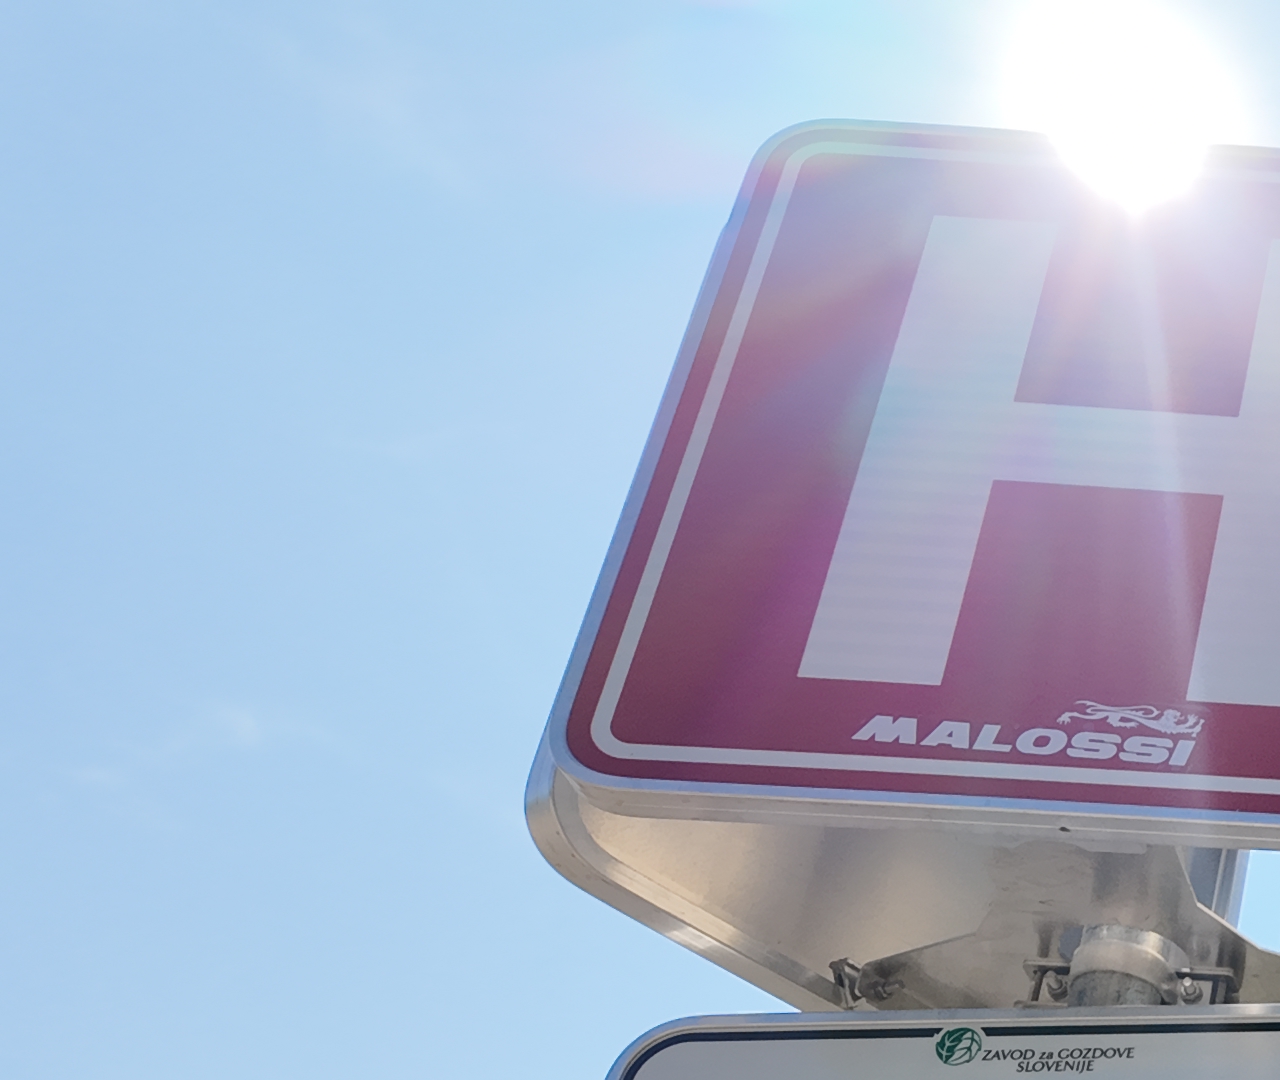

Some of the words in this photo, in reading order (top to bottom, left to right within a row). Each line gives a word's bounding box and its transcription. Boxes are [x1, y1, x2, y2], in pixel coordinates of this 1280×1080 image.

[851, 714, 1197, 767] MALOSSI
[981, 1049, 1035, 1061] ZAVOD
[1039, 1051, 1054, 1060] za
[1057, 1047, 1135, 1060] GOZDOVE
[1016, 1060, 1095, 1074] SLOVENIJE
